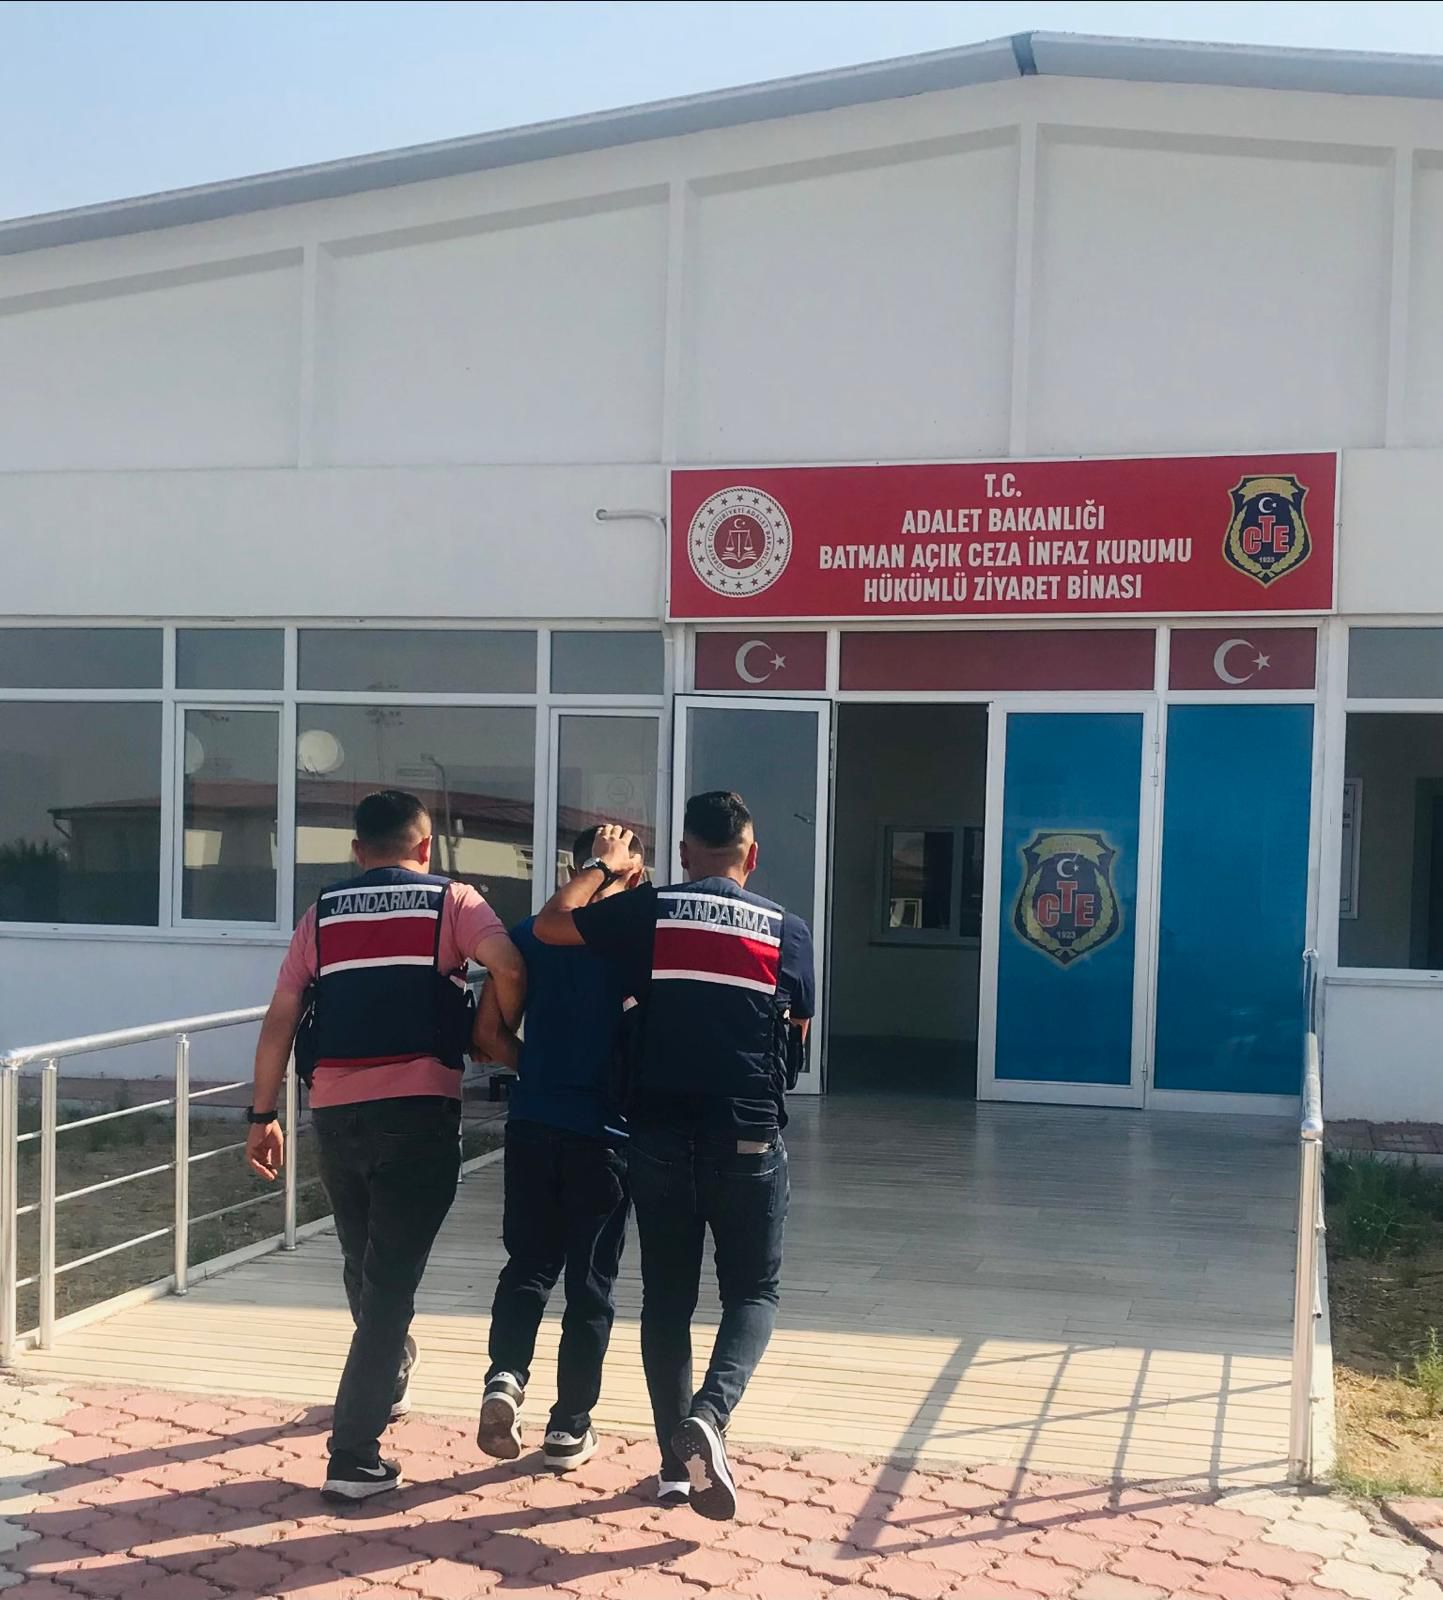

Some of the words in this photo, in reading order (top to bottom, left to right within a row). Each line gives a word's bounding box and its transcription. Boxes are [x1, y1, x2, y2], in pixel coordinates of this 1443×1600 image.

[984, 472, 1022, 498] T.C.
[746, 508, 769, 529] ADALET
[901, 508, 983, 534] ADALET
[988, 499, 1105, 532] BAKANLIĞI
[1243, 515, 1290, 555] CTE
[819, 543, 905, 569] BATMAN
[910, 543, 963, 573] AÇIK
[967, 542, 1022, 568] CEZA
[1028, 535, 1090, 566] İNFAZ
[1096, 537, 1192, 565] KURUMU
[864, 571, 967, 603] HÜKÜMLÜ
[973, 571, 1061, 602] ZİYARET
[1067, 569, 1142, 600] BİNASI
[330, 891, 430, 915] JANDARMA
[668, 899, 772, 937] JANDARMA
[1037, 880, 1095, 928] CTE
